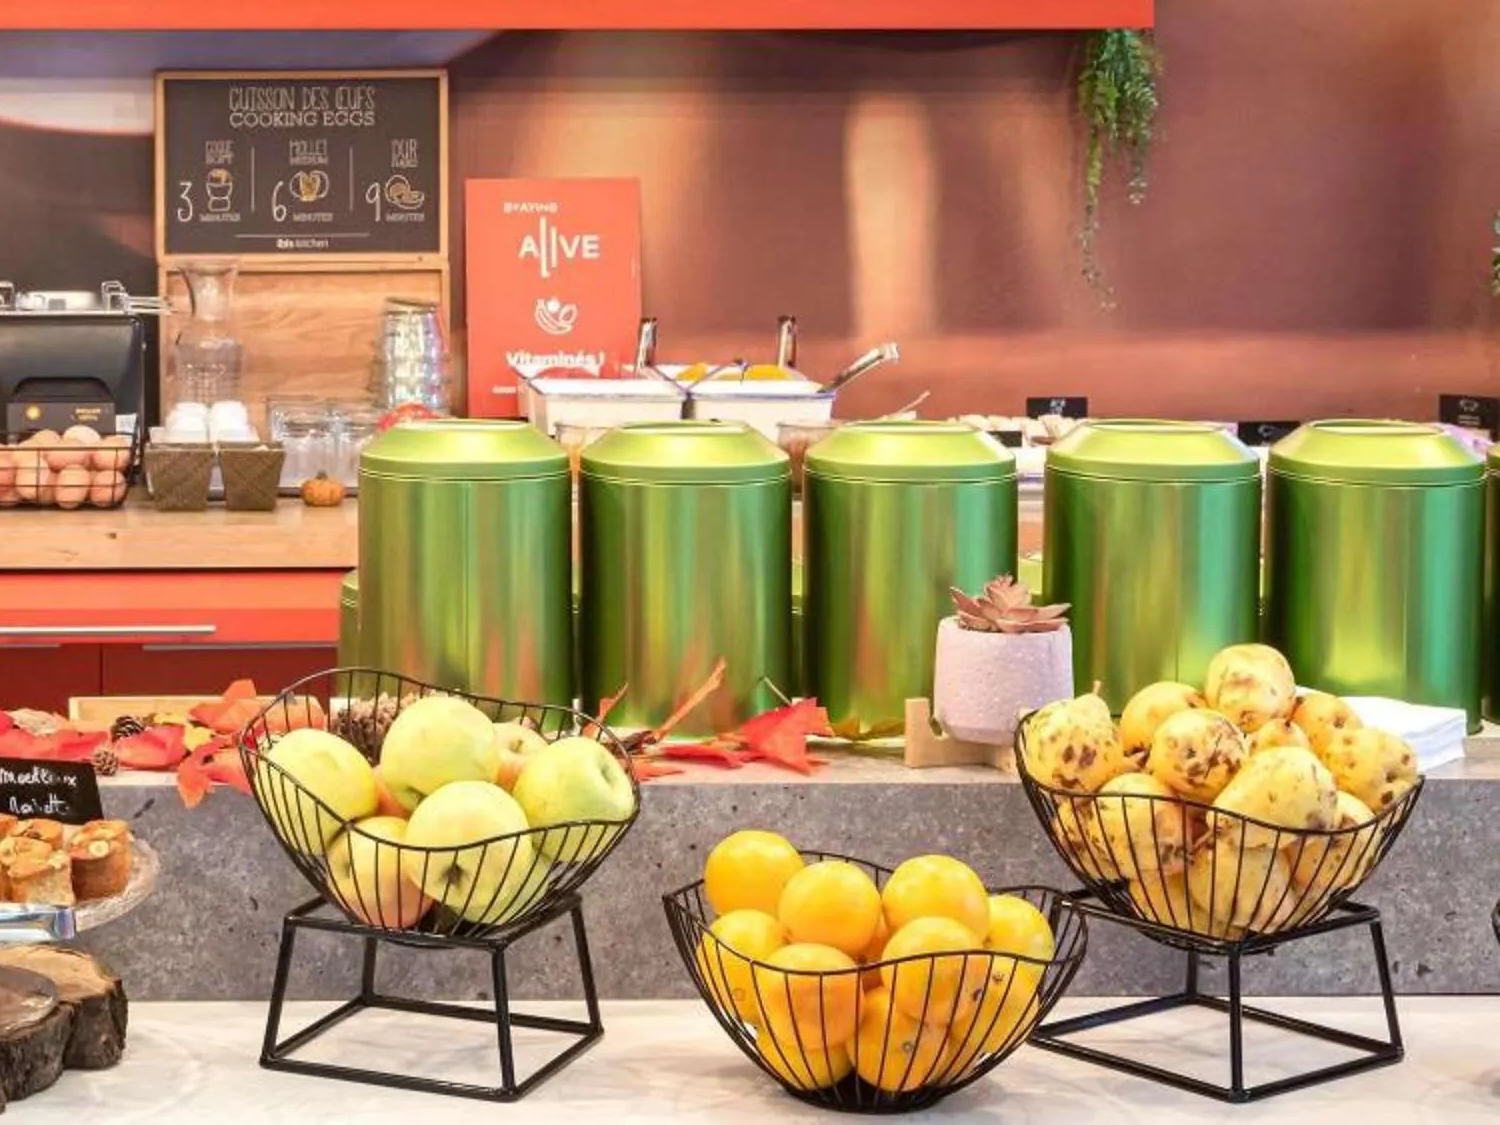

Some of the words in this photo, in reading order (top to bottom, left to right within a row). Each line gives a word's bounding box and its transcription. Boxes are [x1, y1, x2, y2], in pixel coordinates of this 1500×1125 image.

[229, 86, 296, 111] CUISSON
[302, 86, 330, 111] DES
[229, 111, 318, 127] COOKING
[322, 111, 376, 127] EGGS
[176, 180, 194, 223] 3
[271, 180, 287, 223] 6
[365, 182, 381, 222] 9
[518, 217, 601, 279] ALIVE
